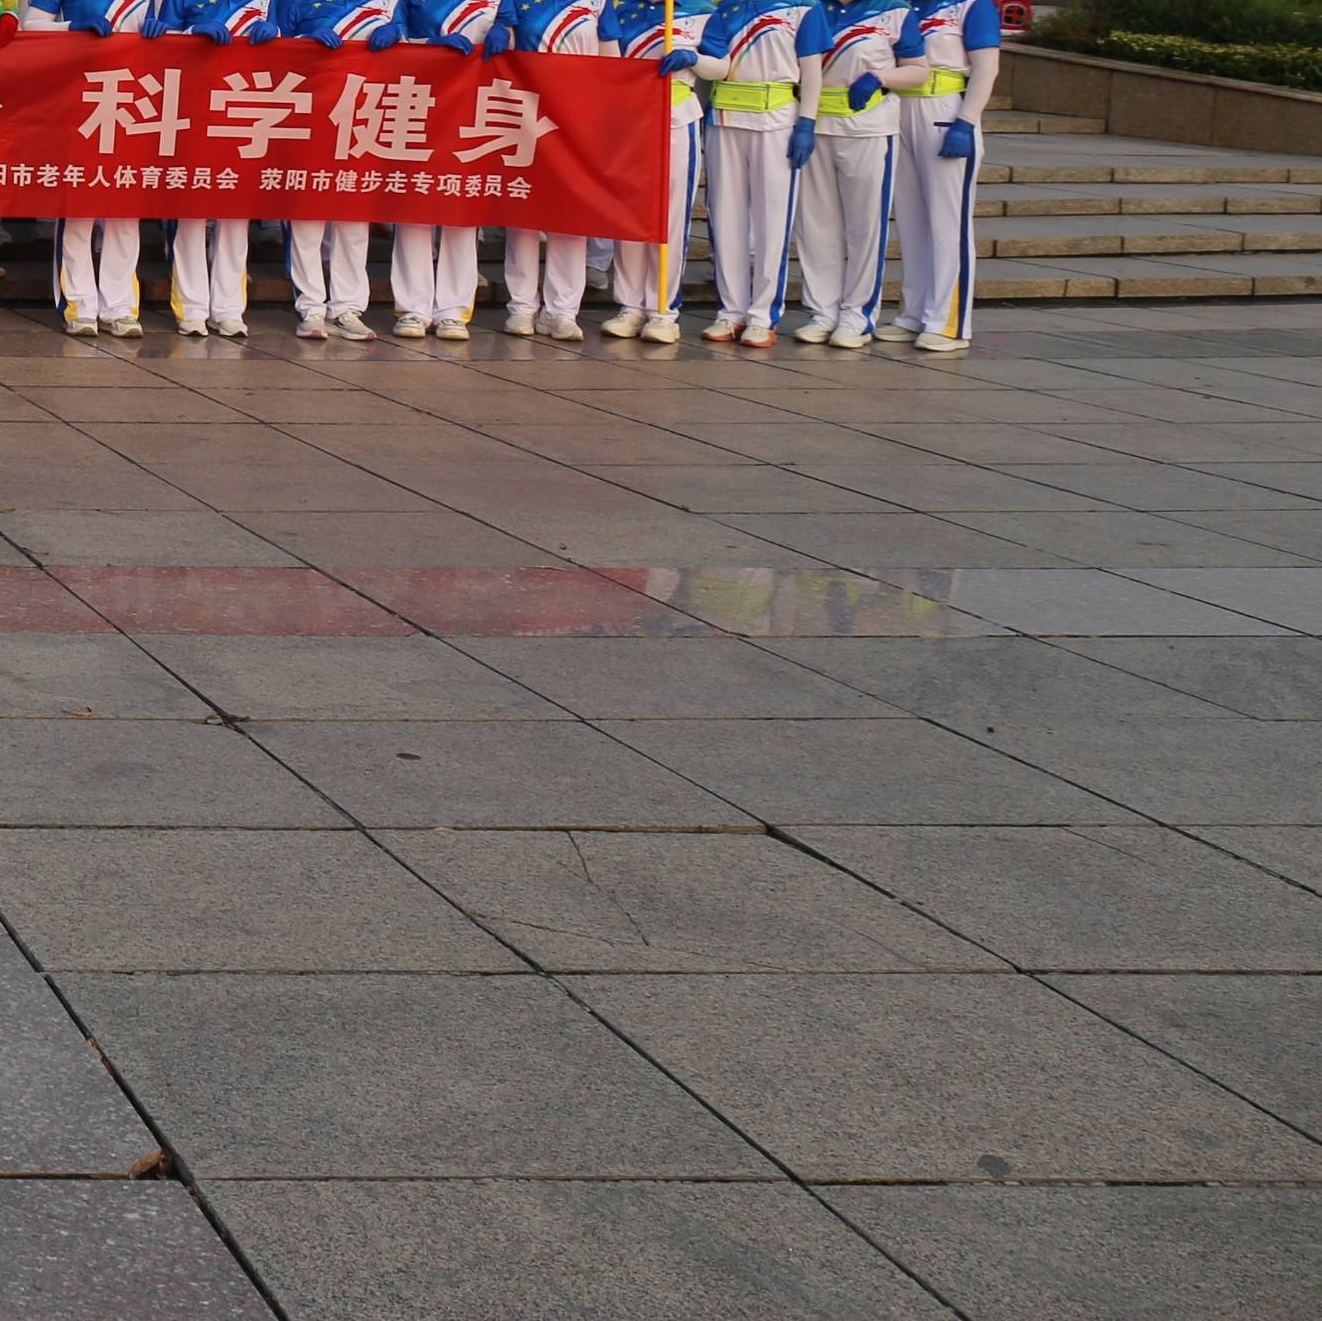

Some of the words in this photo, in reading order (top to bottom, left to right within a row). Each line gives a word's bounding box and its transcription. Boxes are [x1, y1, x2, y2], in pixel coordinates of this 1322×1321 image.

[77, 67, 560, 168] 科学健身
[259, 168, 533, 199] 荥阳市健步走专项委员会
